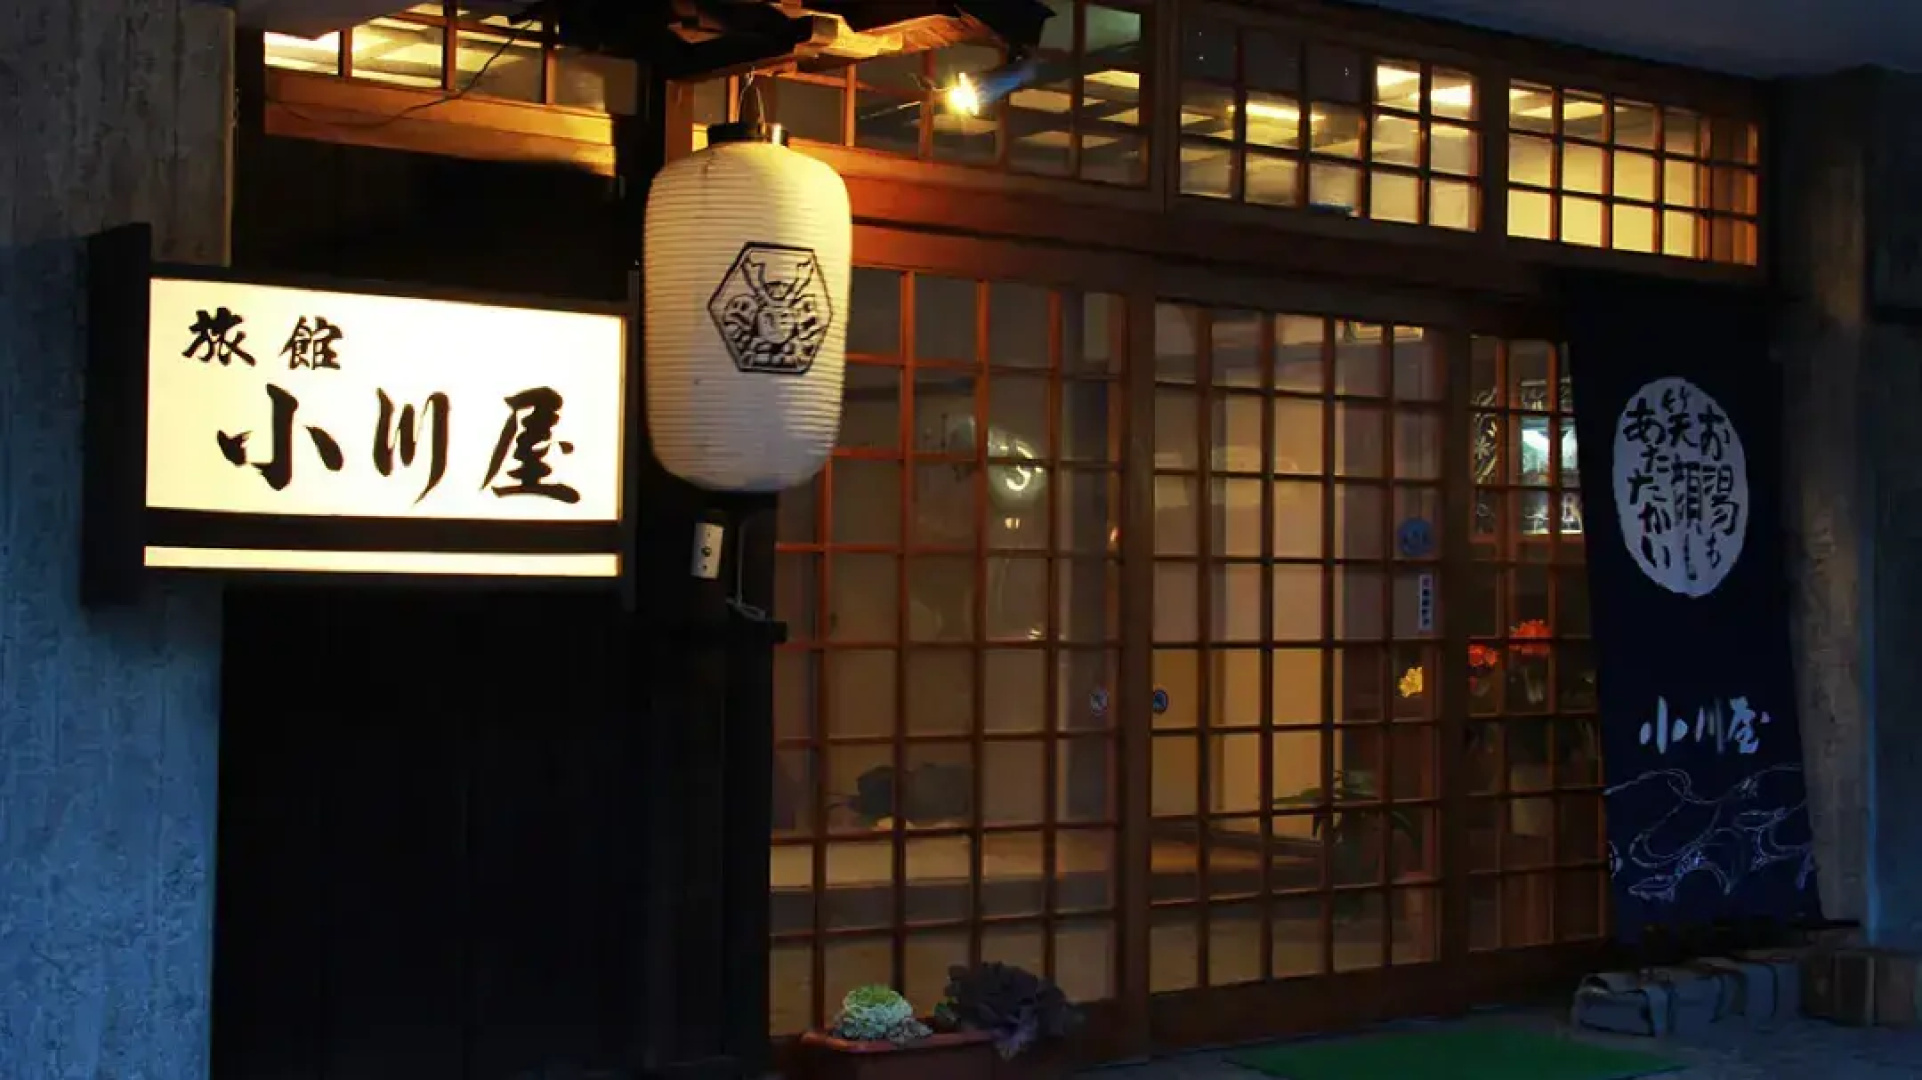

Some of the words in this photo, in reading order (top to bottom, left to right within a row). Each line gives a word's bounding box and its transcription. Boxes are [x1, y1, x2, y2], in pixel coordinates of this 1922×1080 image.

[181, 307, 344, 371] 旅館
[216, 382, 581, 505] 小川屋
[1622, 396, 1672, 570] あたたかい
[1638, 695, 1772, 755] 小川屋
